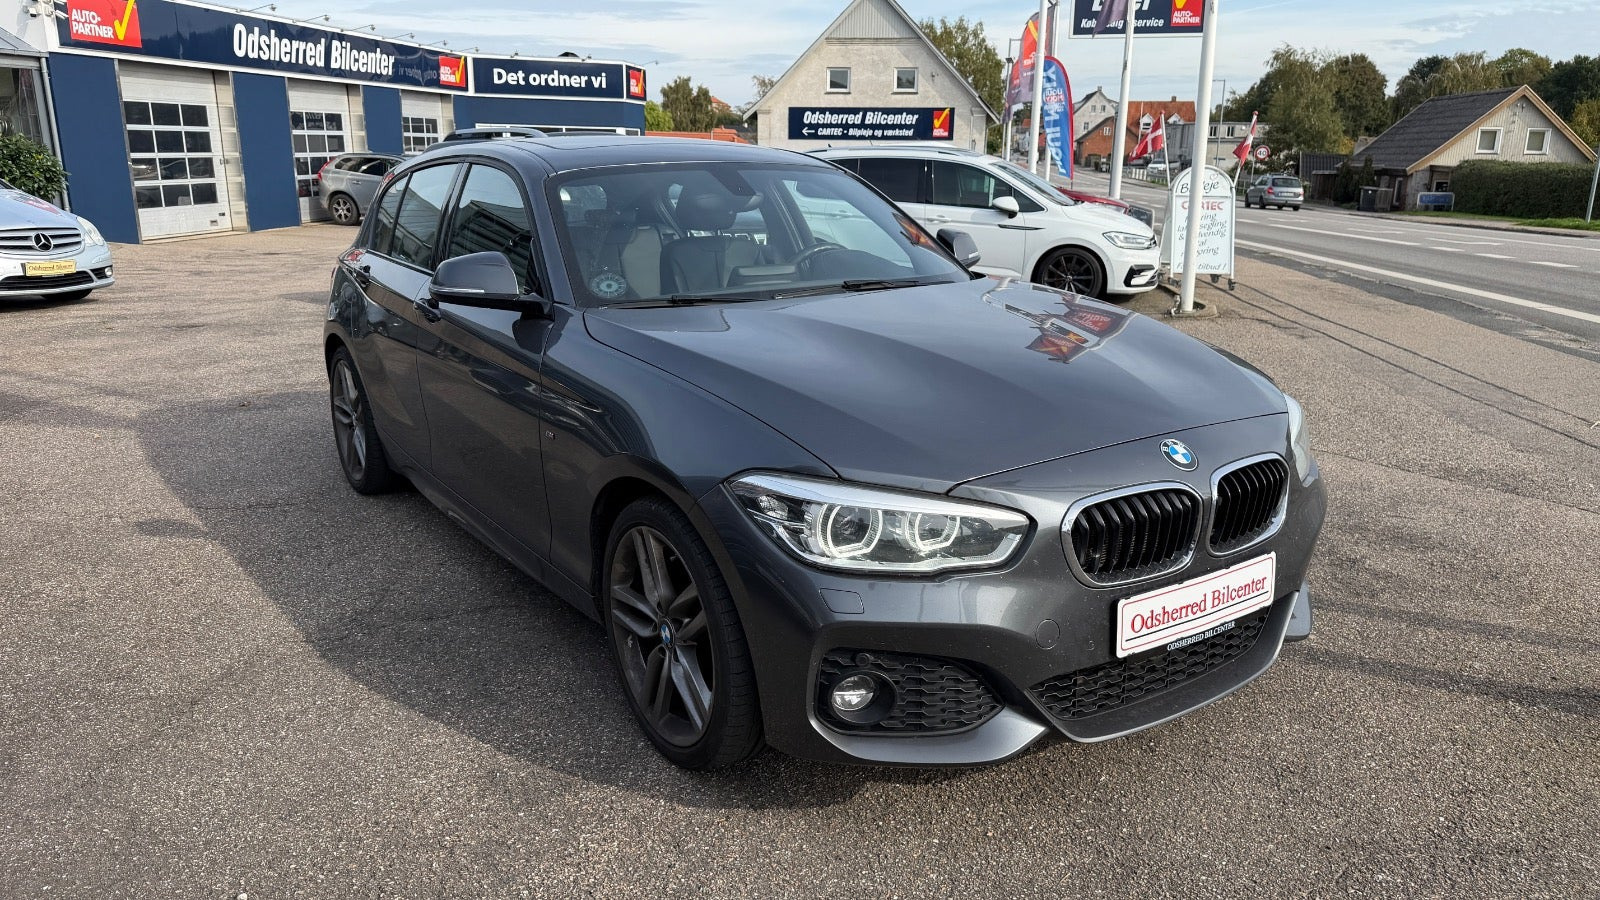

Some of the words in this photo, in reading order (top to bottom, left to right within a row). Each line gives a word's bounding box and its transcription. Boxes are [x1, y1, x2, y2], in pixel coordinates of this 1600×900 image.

[71, 9, 101, 23] AUTO-
[1133, 17, 1164, 27] service
[1172, 16, 1200, 24] PARTNER
[72, 21, 114, 39] PARTNER
[233, 23, 325, 68] Odsherred
[330, 42, 395, 76] Bilcenter
[493, 68, 525, 86] Det
[528, 69, 588, 88] ordner
[591, 72, 606, 88] vi
[803, 110, 862, 125] Odsherred
[864, 110, 919, 125] Bilcenter
[817, 127, 843, 136] CARTEC
[848, 128, 873, 138] Bilpleje
[874, 130, 882, 138] og
[883, 128, 914, 137] værksted
[1130, 593, 1207, 634] Odsherred
[1210, 576, 1267, 608] Bilcenter
[1166, 633, 1204, 651] ODSHERRED
[1204, 621, 1236, 638] BILCENTER
